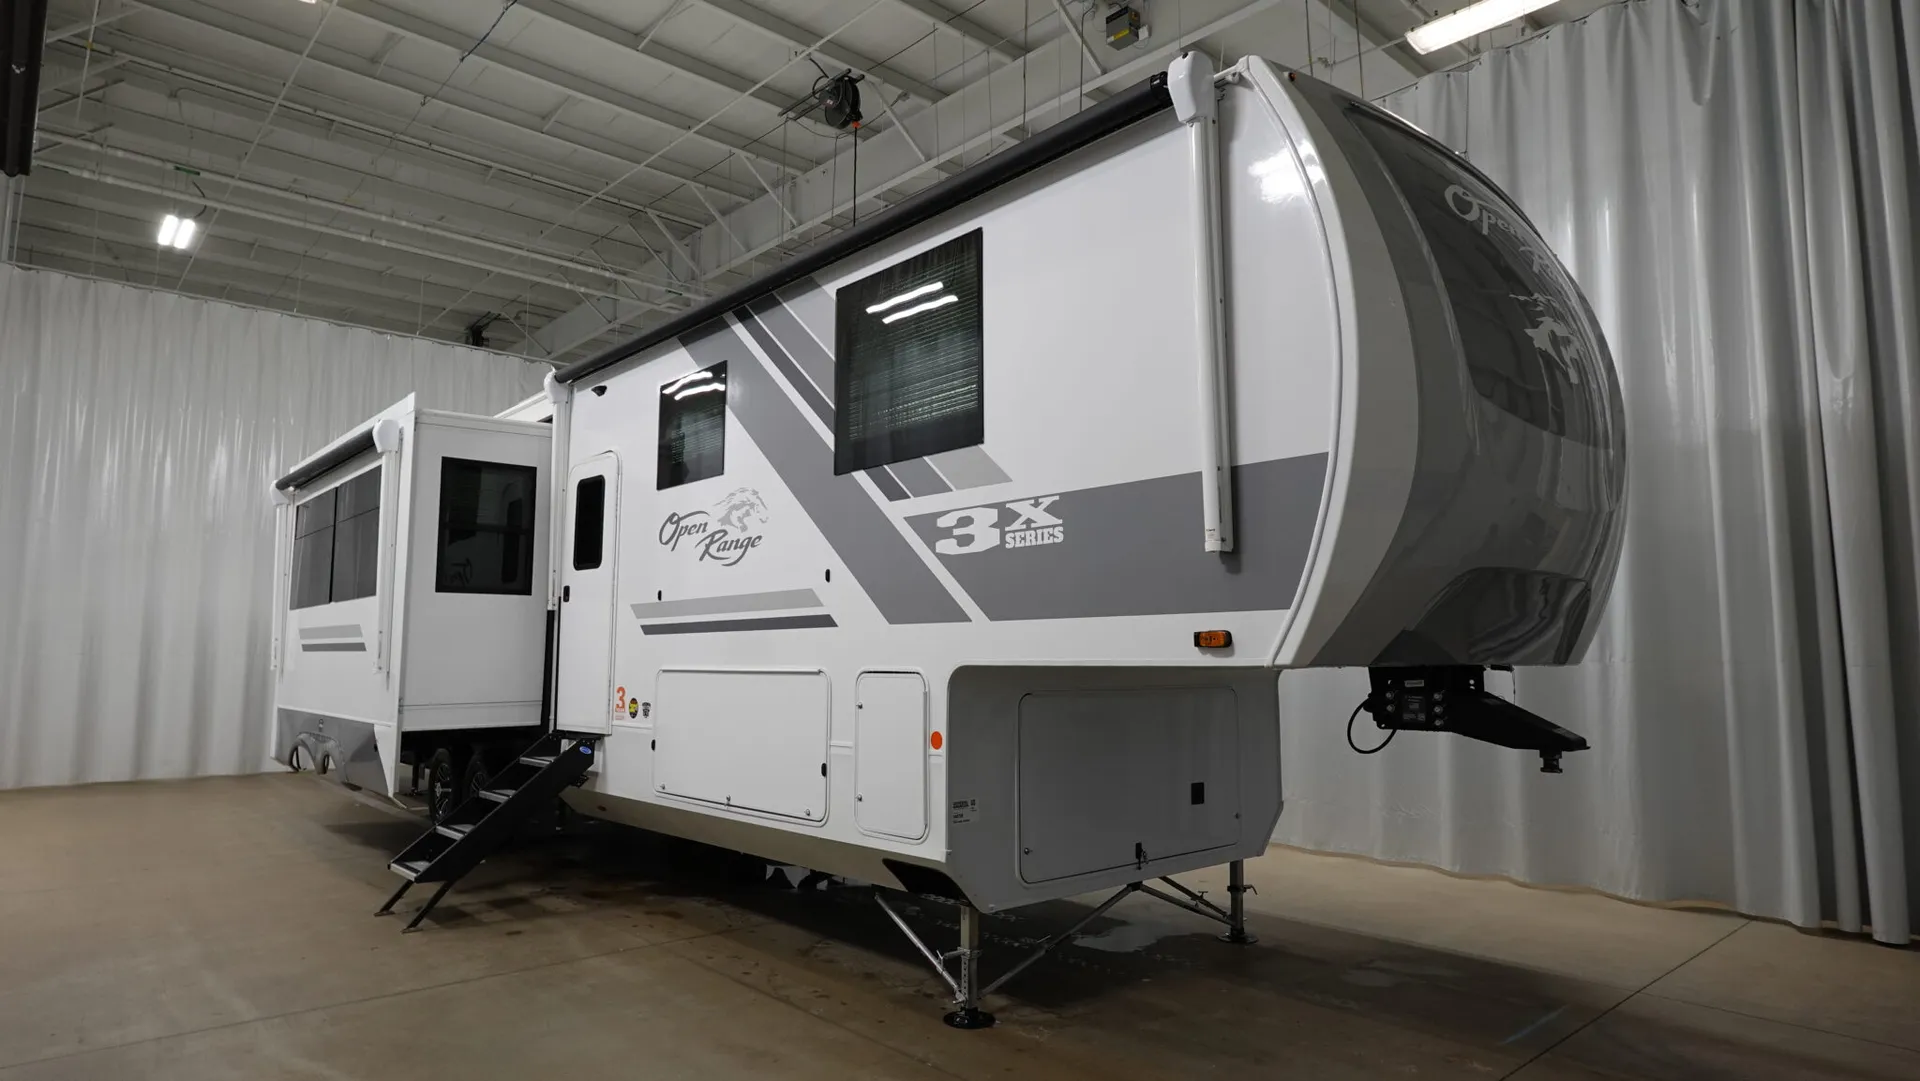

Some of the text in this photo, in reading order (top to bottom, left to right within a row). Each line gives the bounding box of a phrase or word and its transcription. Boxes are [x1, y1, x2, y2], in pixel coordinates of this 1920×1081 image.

[658, 510, 711, 552] Open
[936, 495, 1063, 555] 3 X
[1005, 527, 1064, 549] SERIES
[695, 529, 762, 567] Range
[616, 686, 626, 708] 3
